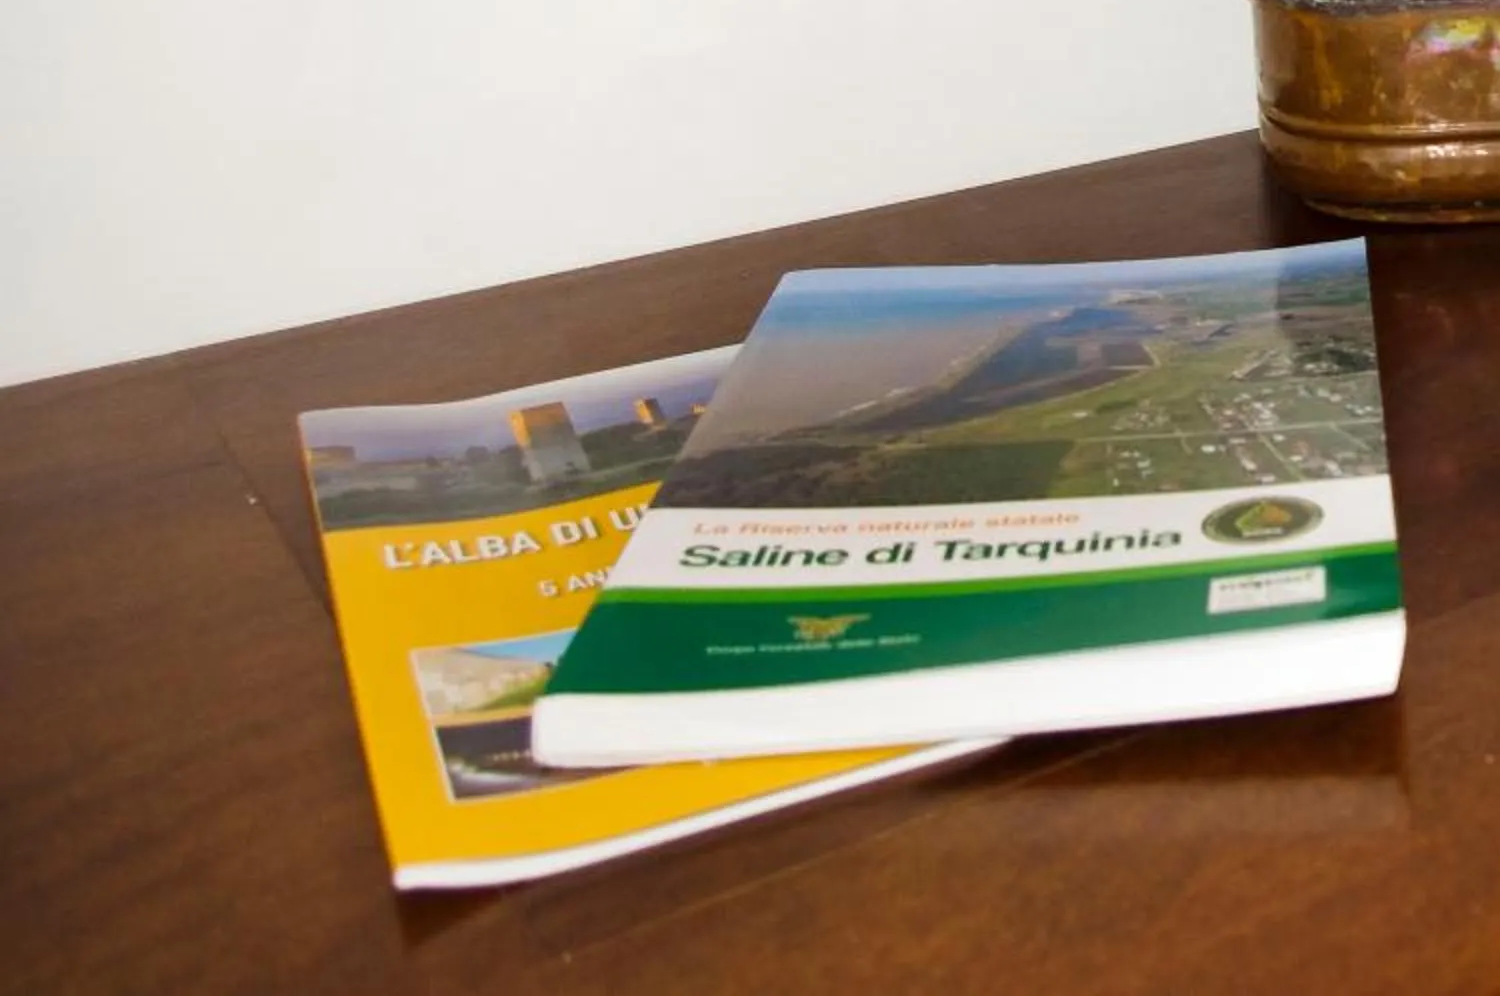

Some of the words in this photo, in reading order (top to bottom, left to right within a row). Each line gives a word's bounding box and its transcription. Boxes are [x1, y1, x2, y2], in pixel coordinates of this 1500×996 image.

[383, 531, 542, 569] L'ALBA
[550, 516, 598, 546] DI
[608, 503, 648, 532] U
[692, 522, 729, 535] La
[739, 521, 848, 536] Riserva
[858, 516, 976, 534] naturale
[984, 511, 1082, 529] statale
[679, 542, 849, 568] Saline
[866, 540, 917, 566] di
[933, 528, 1183, 563] Tarquinia
[538, 579, 559, 597] 5
[568, 566, 613, 592] AN
